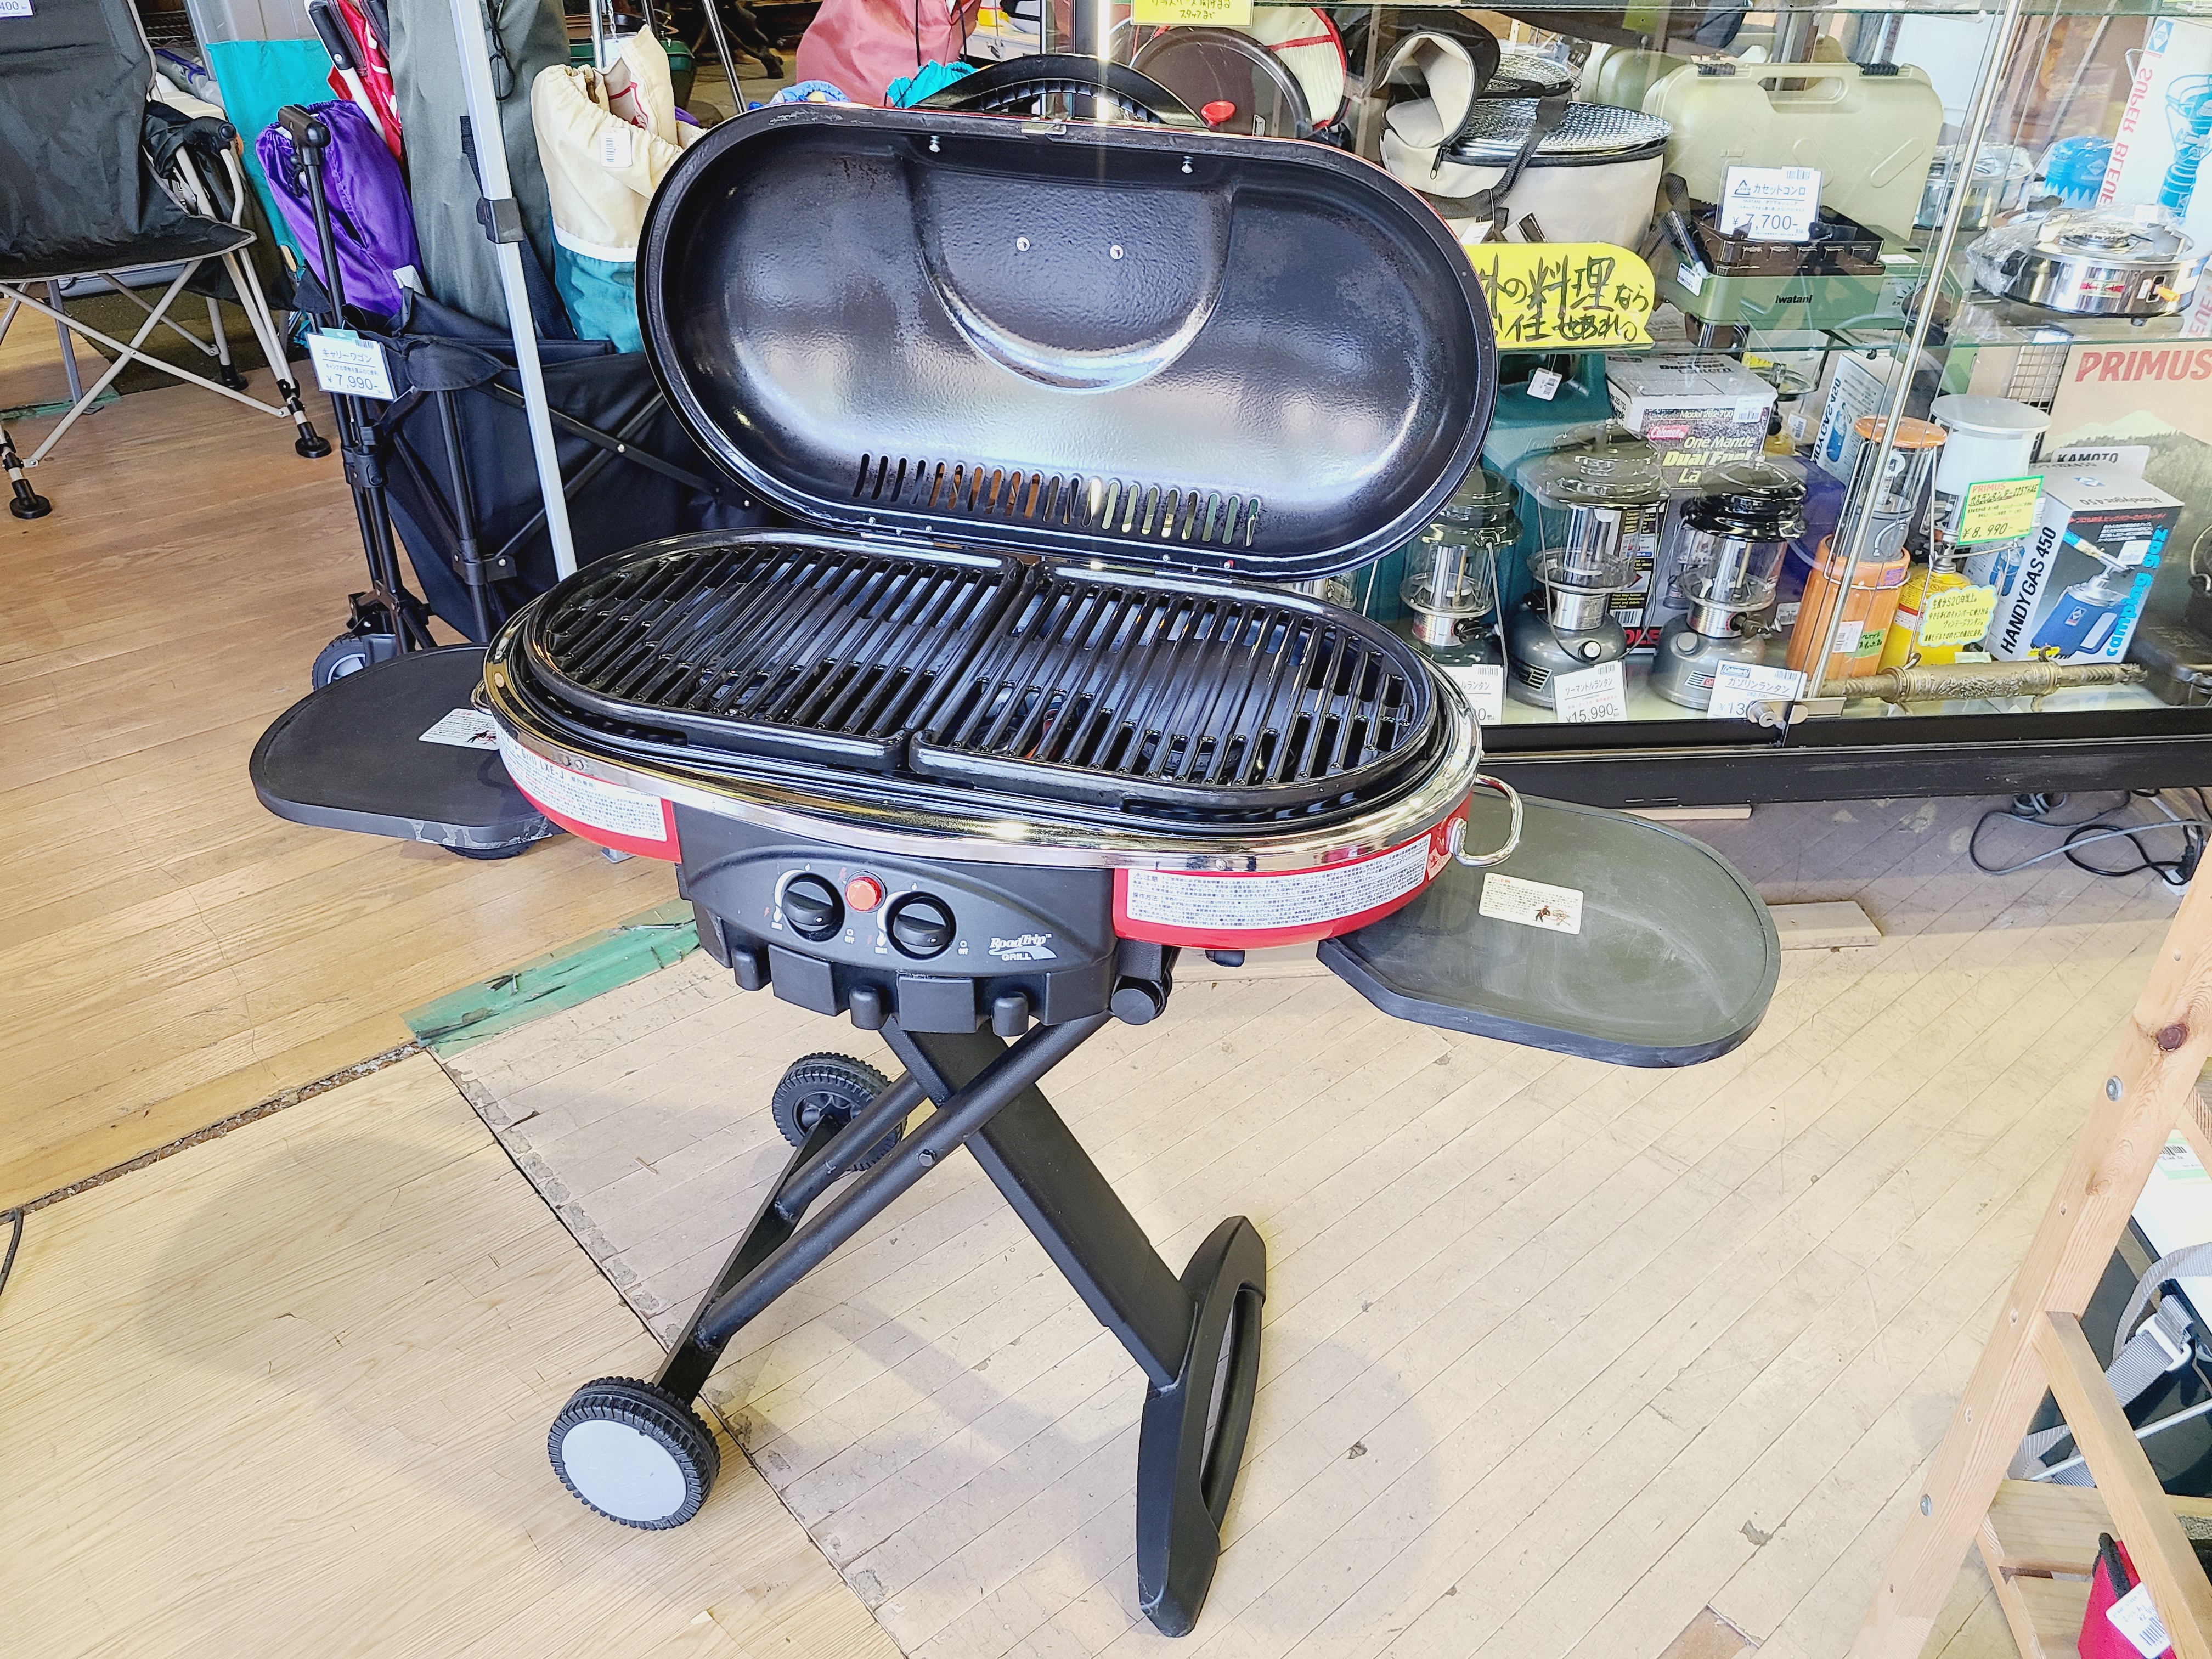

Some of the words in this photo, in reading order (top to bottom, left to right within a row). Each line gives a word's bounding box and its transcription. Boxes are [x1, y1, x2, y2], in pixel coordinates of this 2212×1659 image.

[1753, 183, 1805, 196] カセットコンロ
[322, 348, 372, 363] キャリーワゴン
[2075, 349, 2212, 382] PRIMUS
[1684, 437, 1710, 448] One
[1711, 437, 1756, 448] Mantle
[1662, 451, 1707, 466] Dual
[1972, 482, 2006, 493] PRIMUS
[2036, 526, 2057, 562] 450
[2106, 572, 2153, 657] camping
[2142, 524, 2169, 569] gaz
[1565, 678, 1613, 696] ツーマントルランタン
[1728, 677, 1790, 694] ガソリンランタン
[1132, 892, 1158, 901] 操作方法
